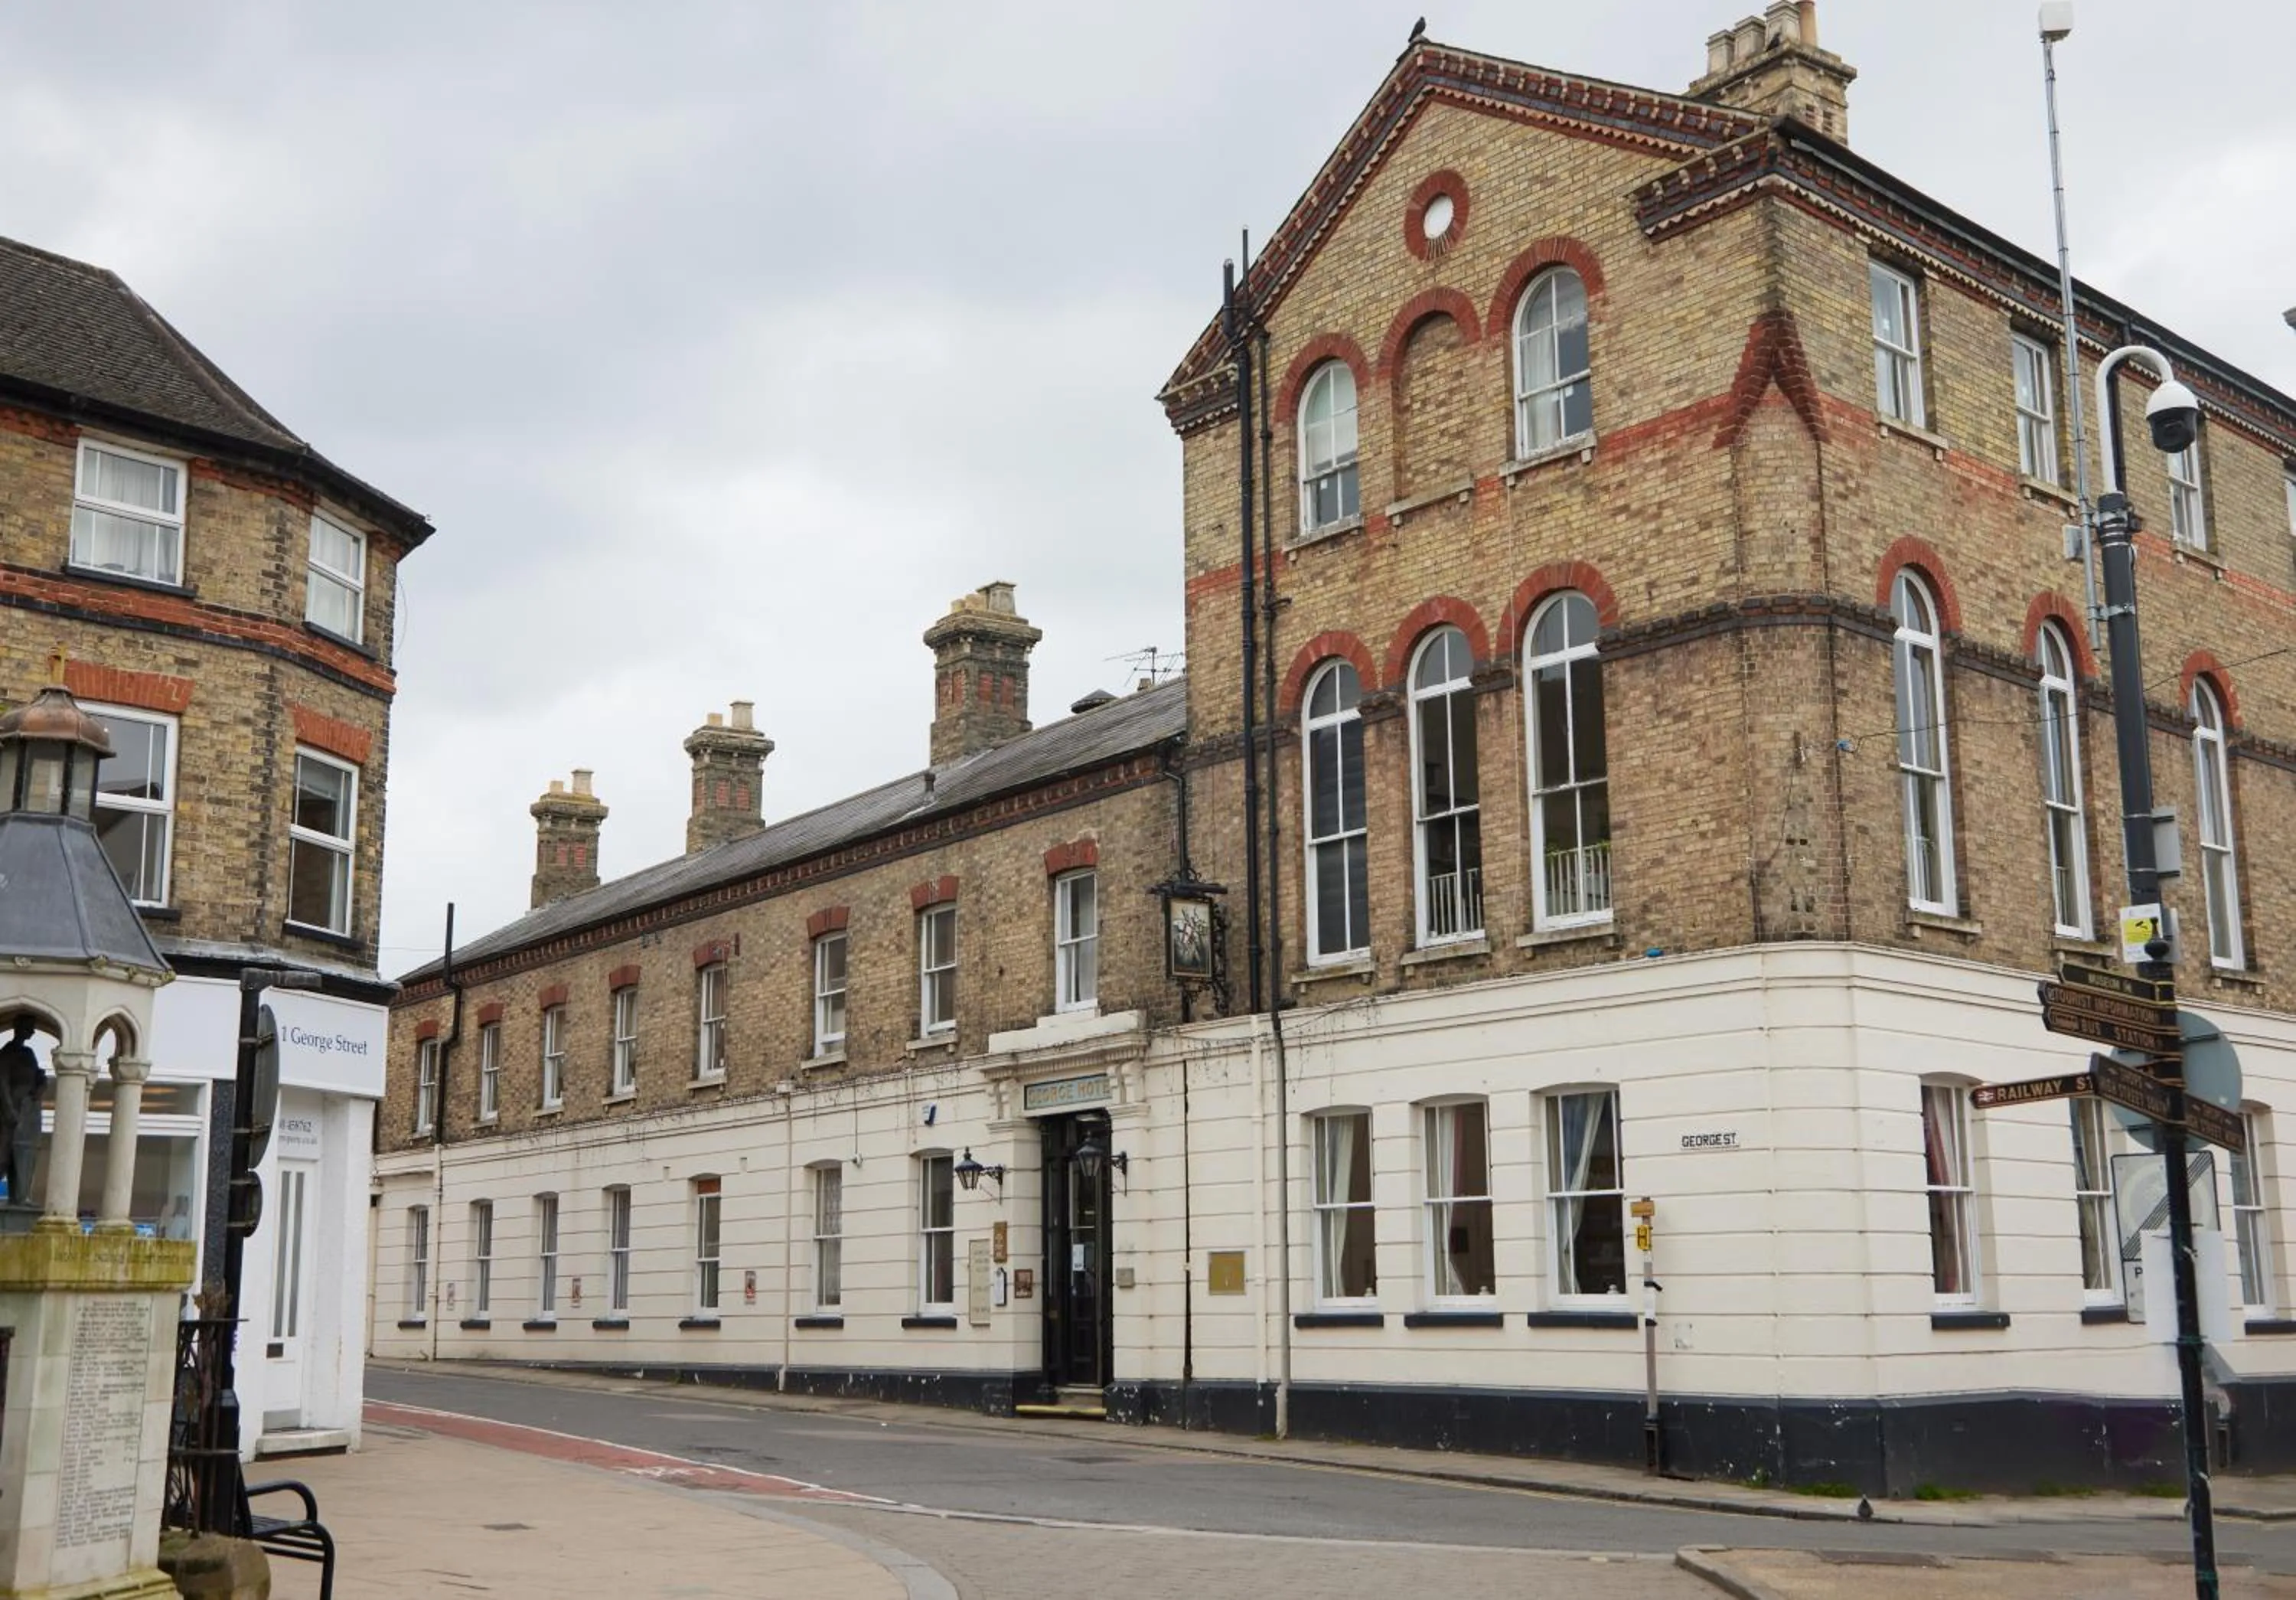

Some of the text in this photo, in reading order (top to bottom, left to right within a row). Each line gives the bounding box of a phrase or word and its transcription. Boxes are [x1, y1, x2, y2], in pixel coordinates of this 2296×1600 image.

[2054, 987, 2160, 1025] TOURIST INFORMATION
[282, 1026, 367, 1055] 1 George Street
[2081, 1018, 2164, 1050] BUS STATION
[1078, 1077, 1110, 1098] HOTE
[1997, 1079, 2063, 1101] RAILWAY
[1681, 1132, 1737, 1147] GEORGE ST
